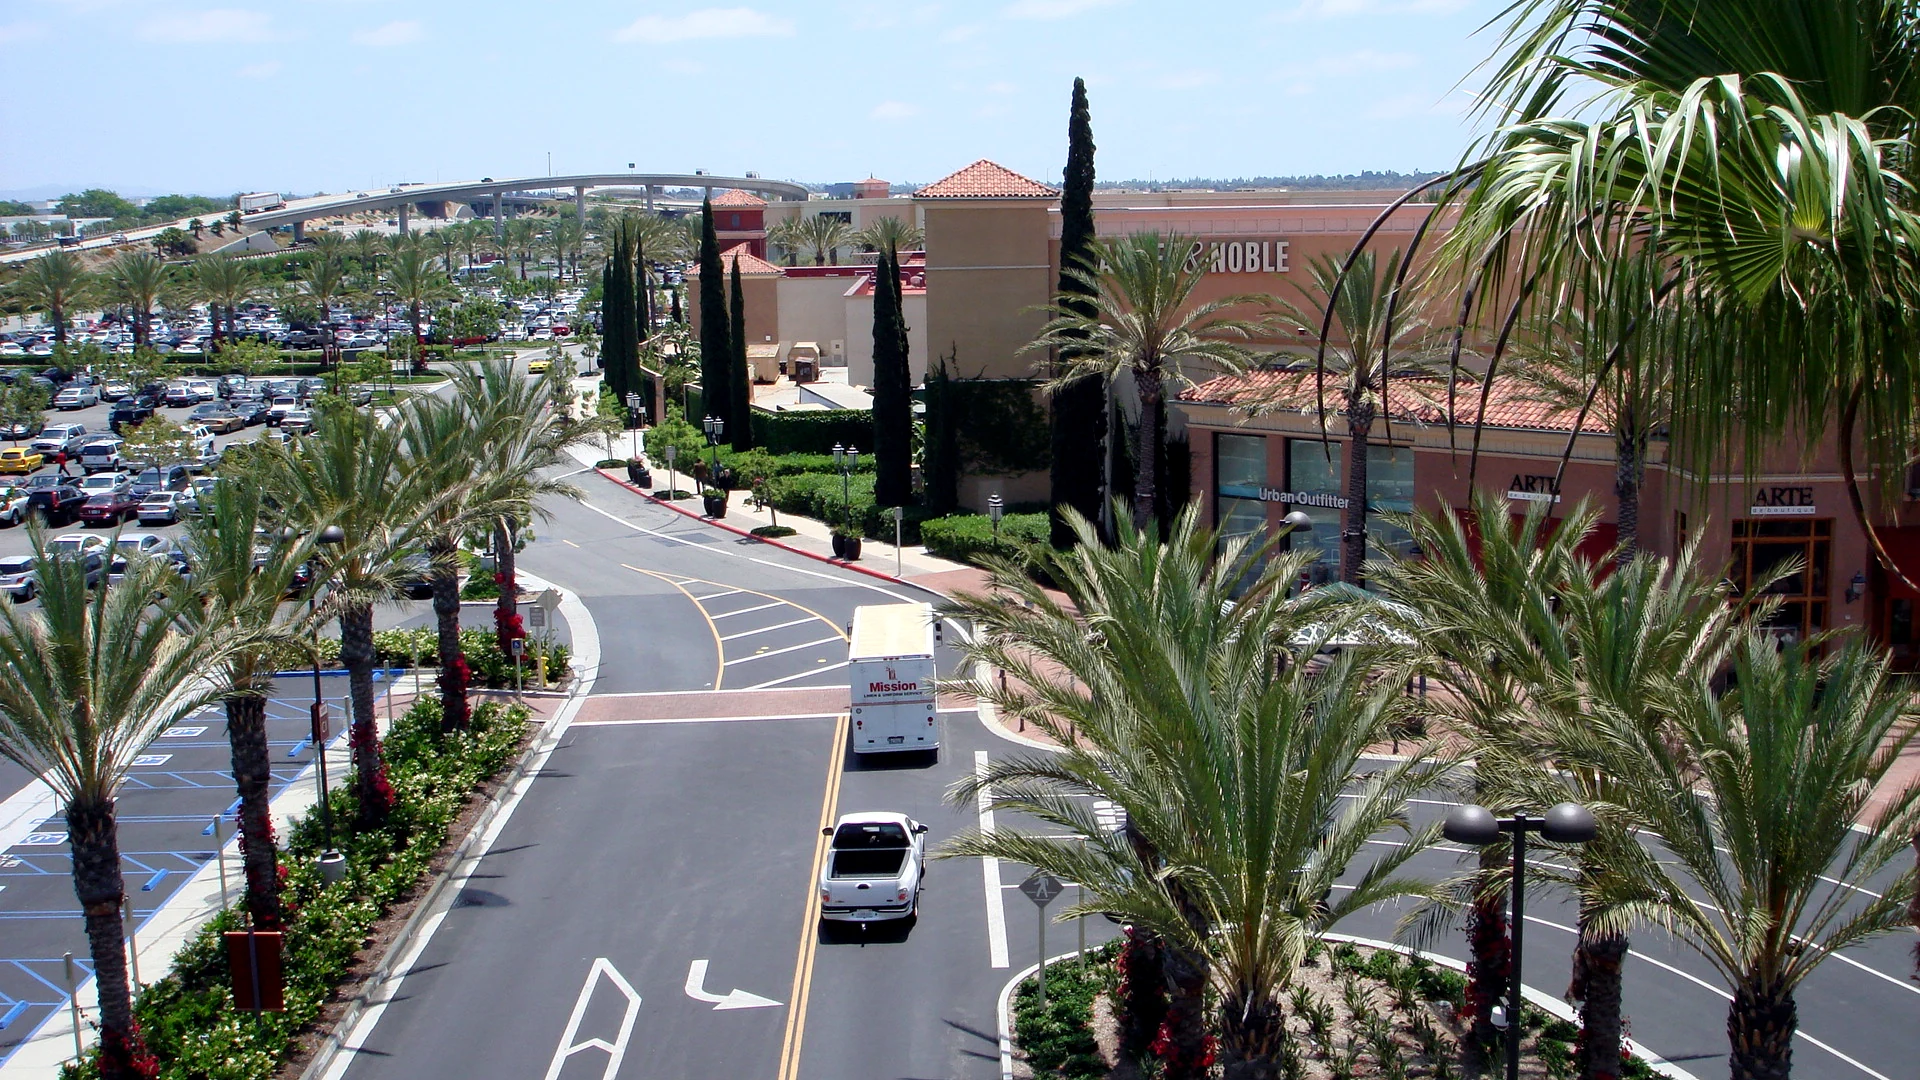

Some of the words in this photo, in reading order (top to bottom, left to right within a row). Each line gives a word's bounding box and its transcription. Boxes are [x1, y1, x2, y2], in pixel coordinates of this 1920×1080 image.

[1210, 241, 1290, 272] NOBLE
[1259, 487, 1295, 503] Urban
[1752, 487, 1815, 506] ARTE
[869, 681, 917, 692] Mission
